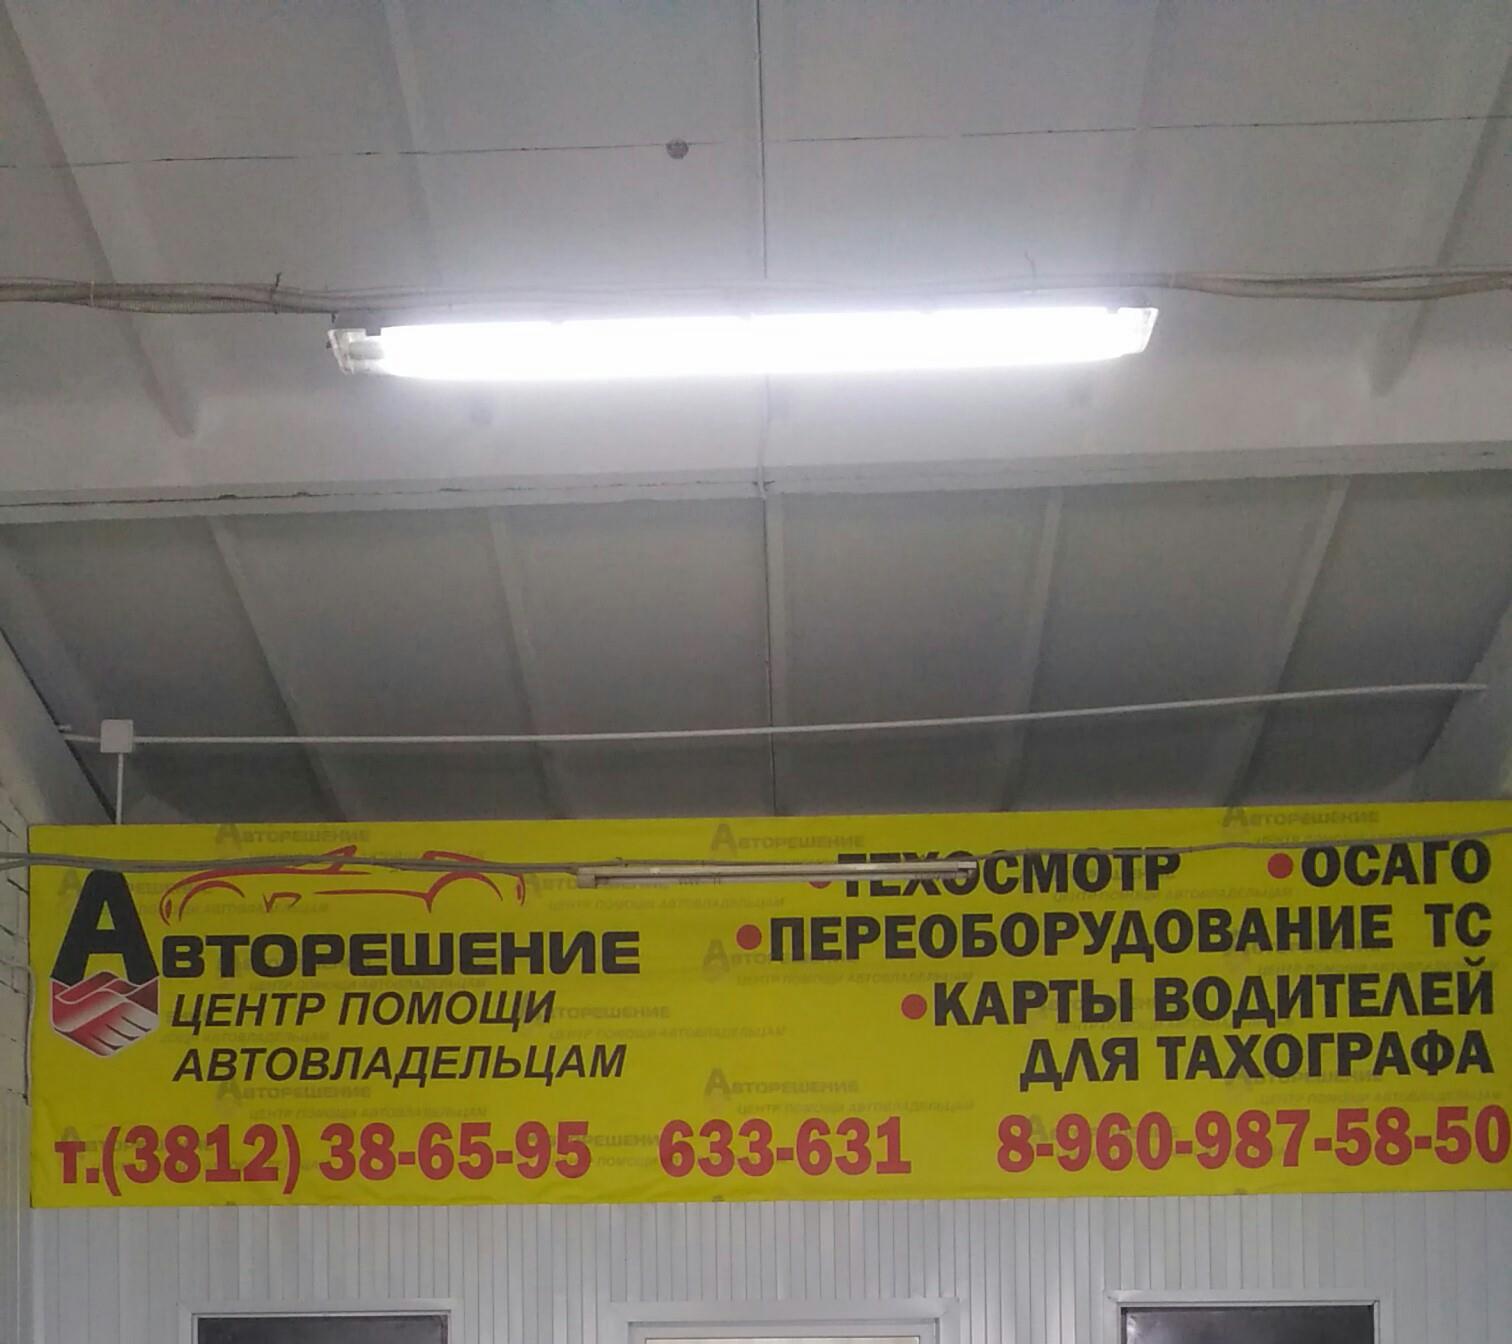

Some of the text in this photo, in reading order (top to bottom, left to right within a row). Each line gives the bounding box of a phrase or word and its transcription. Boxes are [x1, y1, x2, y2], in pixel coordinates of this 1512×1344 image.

[1301, 838, 1492, 888] ОСАГО
[770, 903, 1393, 963] ПЕРЕОБОРУДОВАНИЕ
[1424, 902, 1492, 947] ТС
[170, 990, 557, 1035] ЦЕНТР ПОМОЩИ
[934, 955, 1494, 1029] КАРТЫ ВОДИТЕЛЕЙ
[171, 1044, 628, 1088] АВТОВЛАДЕЛЬЦАМ
[1019, 1029, 1495, 1092] ДЛЯ ТАХОГРАФА
[319, 1121, 592, 1181] 38-65-95
[658, 1116, 912, 1178] 633-631
[996, 1104, 1511, 1173] 8-960-987-58-50
